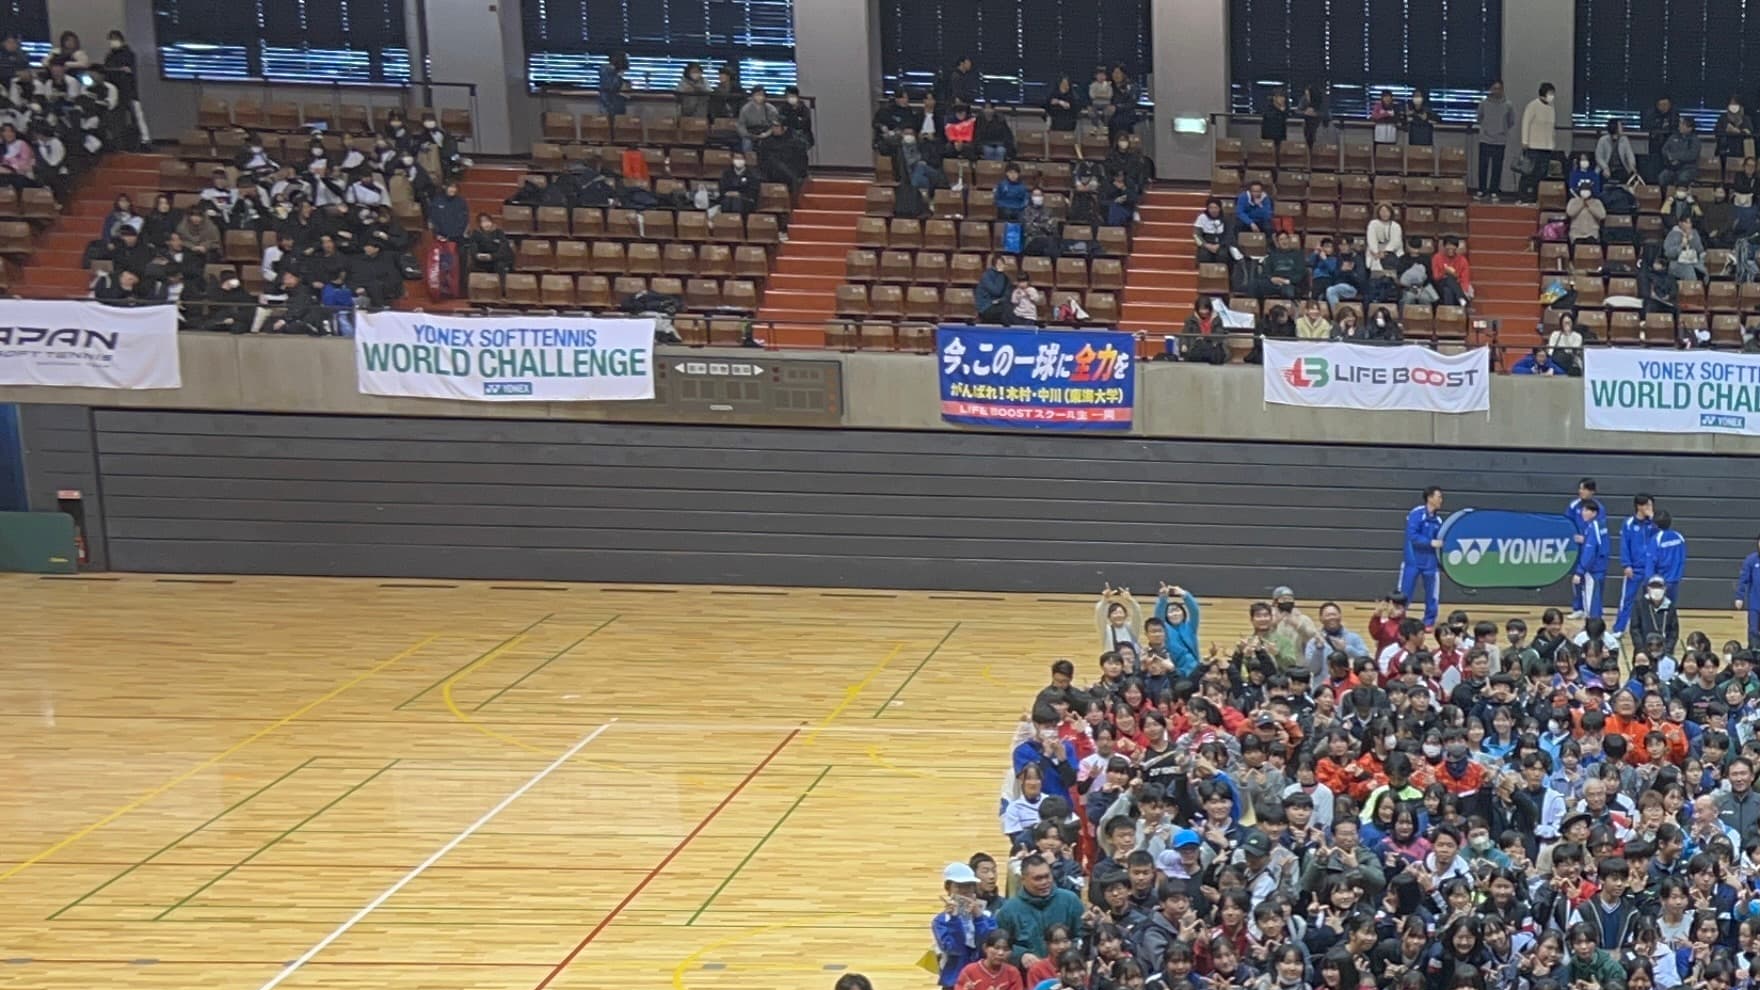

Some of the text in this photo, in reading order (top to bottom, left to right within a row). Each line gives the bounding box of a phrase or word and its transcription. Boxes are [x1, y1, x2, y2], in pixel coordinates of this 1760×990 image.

[413, 324, 474, 347] YONEX
[363, 342, 646, 378] WORLD CHALLENGE
[943, 336, 1129, 381] 今、この一球に全力を
[1638, 361, 1696, 381] YONEX
[1335, 364, 1479, 388] LIFE BOOST
[1591, 380, 1692, 409] WORLD
[1717, 416, 1745, 428] YONEX
[1497, 537, 1570, 564] YONEX
